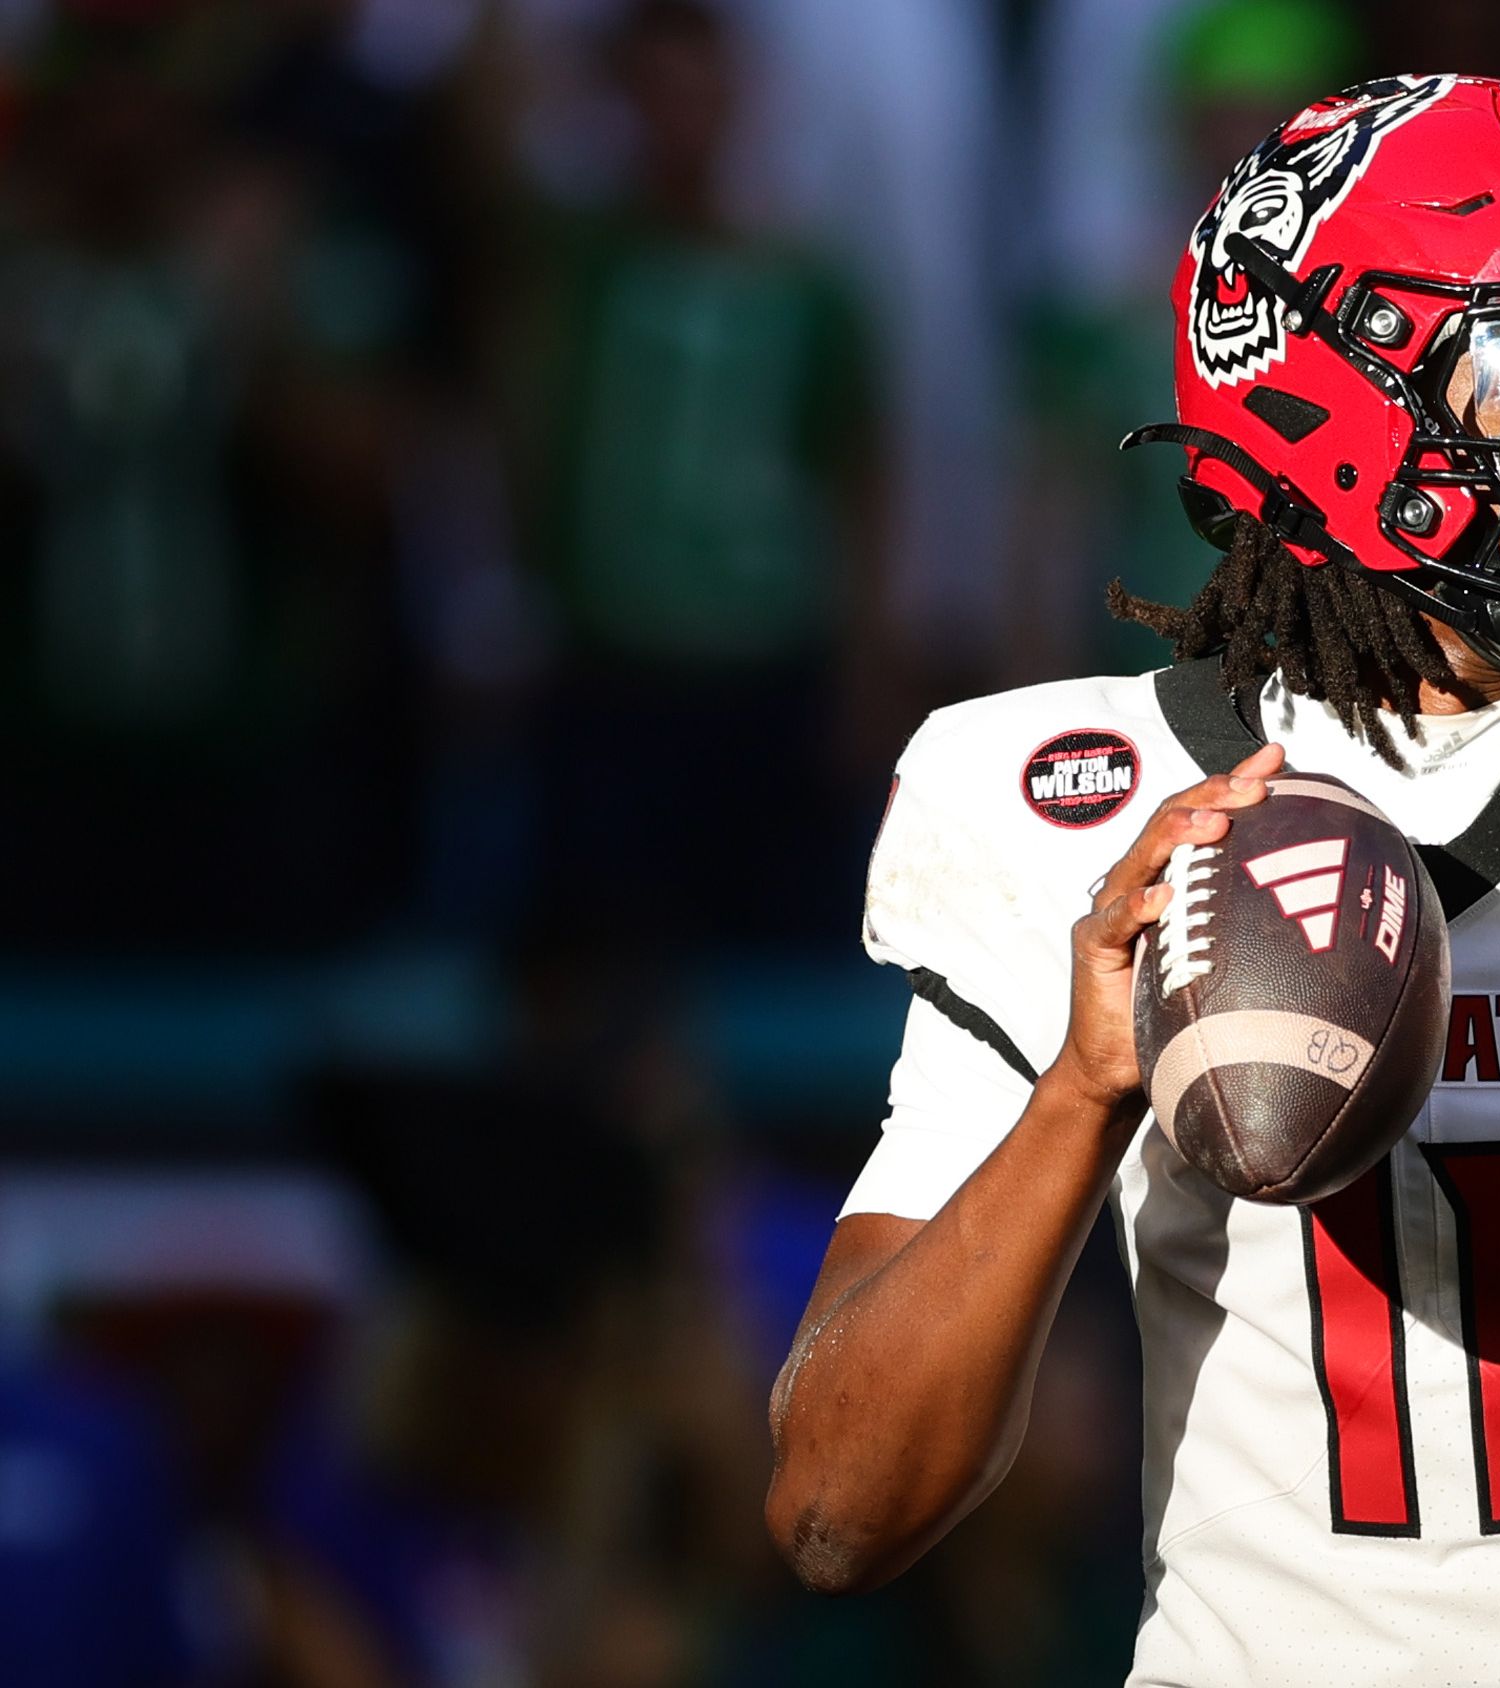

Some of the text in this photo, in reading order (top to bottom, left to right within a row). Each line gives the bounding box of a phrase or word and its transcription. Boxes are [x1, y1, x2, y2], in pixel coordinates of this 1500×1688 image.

[1031, 766, 1131, 799] WILSON
[1053, 755, 1109, 775] PAYTON
[1374, 863, 1406, 964] DIME
[1307, 1029, 1359, 1073] QB
